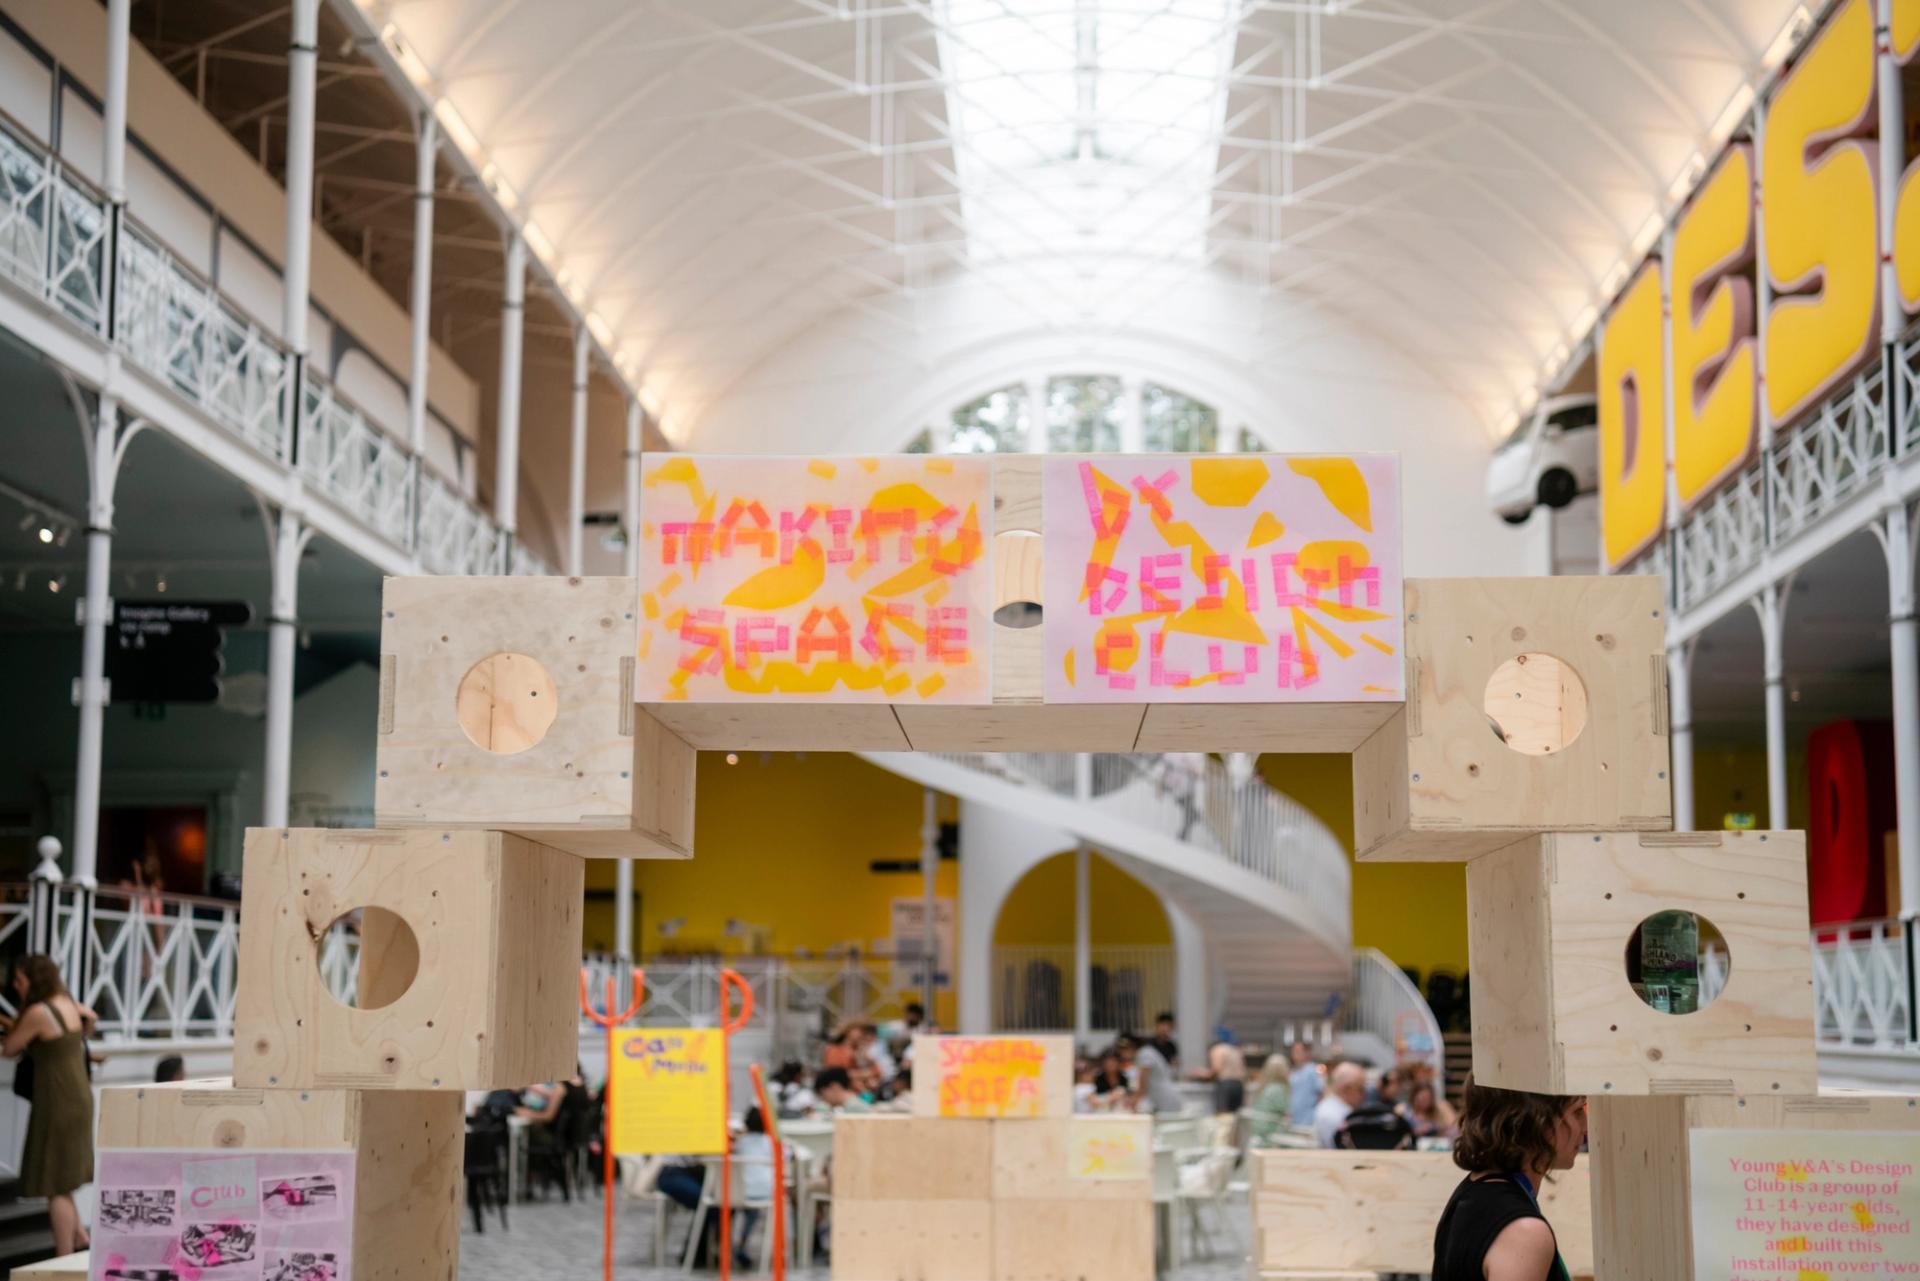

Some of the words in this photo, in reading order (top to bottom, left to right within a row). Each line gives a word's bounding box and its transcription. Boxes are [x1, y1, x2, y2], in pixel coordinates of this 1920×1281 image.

[661, 501, 982, 576] TAKING
[1086, 553, 1380, 615] DESIGN
[678, 606, 968, 675] SPACE
[1095, 632, 1320, 690] CLUB
[939, 1037, 1046, 1068] SOCIAL
[943, 1074, 1038, 1105] SOFA
[1729, 1158, 1787, 1176] Young
[1790, 1159, 1846, 1175] V&A's
[1850, 1160, 1913, 1178] Design
[1743, 1178, 1786, 1193] Club
[1790, 1178, 1804, 1193] is
[1809, 1182, 1818, 1194] a
[1823, 1182, 1877, 1197] group
[1881, 1179, 1900, 1195] of
[1736, 1217, 1776, 1235] they
[1780, 1217, 1824, 1233] have
[1828, 1219, 1911, 1236] designed
[1765, 1238, 1799, 1252] and
[1802, 1237, 1843, 1252] built
[1848, 1238, 1883, 1254] this
[1731, 1255, 1834, 1272] installation
[1838, 1260, 1879, 1273] over
[1884, 1259, 1920, 1274] two
